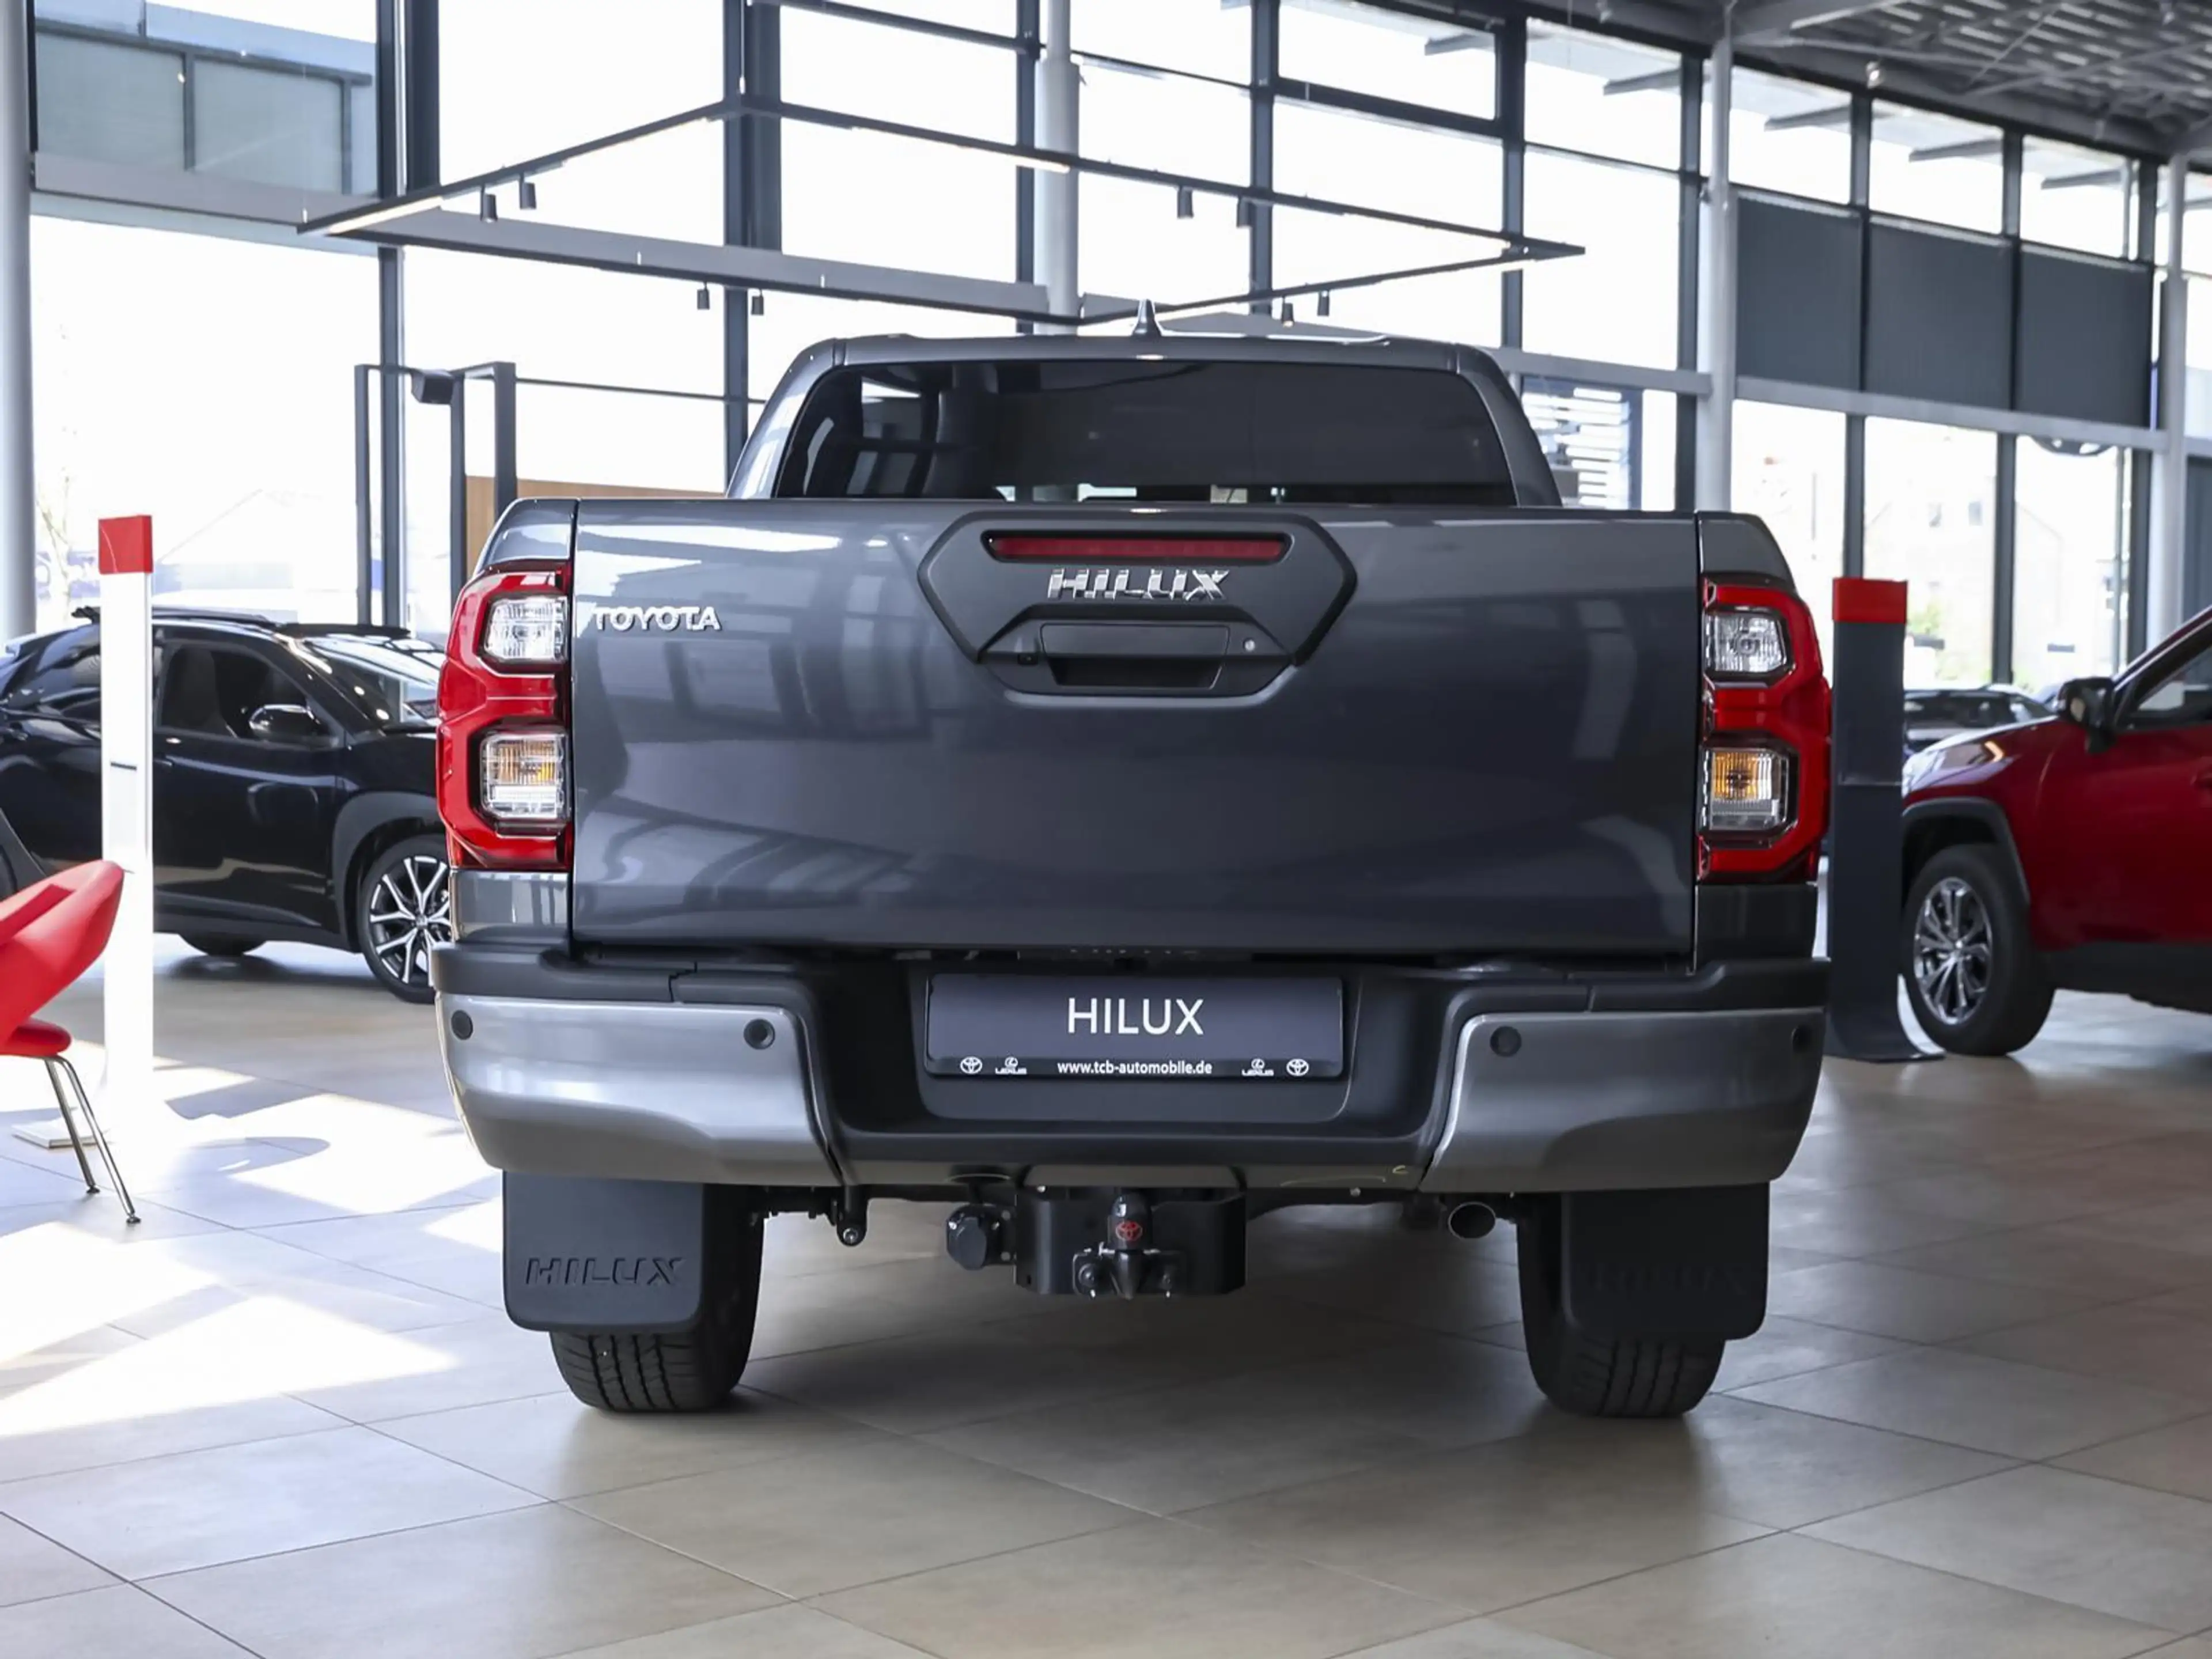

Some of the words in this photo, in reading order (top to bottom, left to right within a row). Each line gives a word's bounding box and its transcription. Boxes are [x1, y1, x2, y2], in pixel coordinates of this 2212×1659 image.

[1048, 569, 1230, 601] HILUX
[593, 607, 721, 631] TOYOTA
[1068, 998, 1205, 1035] HILUX
[1057, 1060, 1213, 1074] www.tcb-automobile.de
[525, 1256, 683, 1285] HILUX
